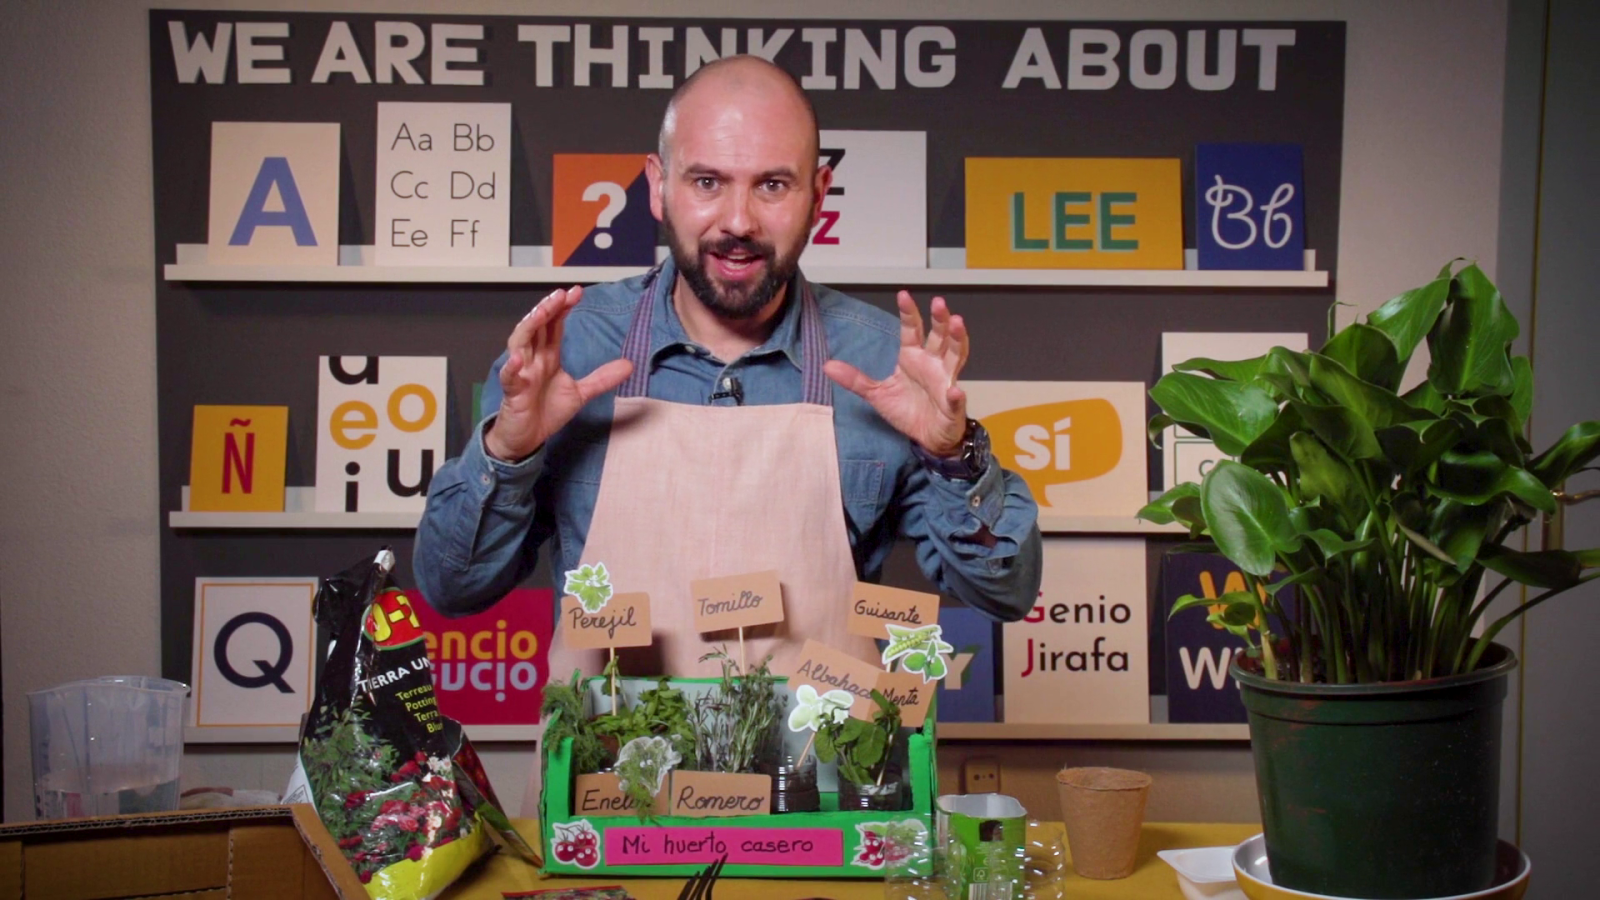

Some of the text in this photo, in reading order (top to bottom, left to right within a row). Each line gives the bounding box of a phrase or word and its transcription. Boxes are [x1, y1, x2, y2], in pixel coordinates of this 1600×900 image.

[169, 21, 291, 84] WE
[311, 21, 486, 86] ARE
[1001, 28, 1296, 91] ABOUT
[391, 122, 495, 152] Aa Bb
[391, 171, 496, 200] Cc Dd
[228, 156, 318, 247] A
[391, 218, 480, 248] Ee Ff
[1010, 191, 1140, 253] LEE
[329, 400, 379, 450] e
[221, 417, 256, 495] Ñ
[698, 590, 764, 617] Tomillo
[854, 599, 922, 624] Guisante
[569, 606, 637, 640] Perejil
[213, 611, 295, 694] Q
[1020, 636, 1130, 678] Jirafa
[358, 666, 411, 693] TIERRA
[395, 684, 433, 701] Terreau
[882, 687, 920, 706] Menta
[676, 785, 765, 811] Romero
[622, 831, 814, 855] Mi huerto casero
